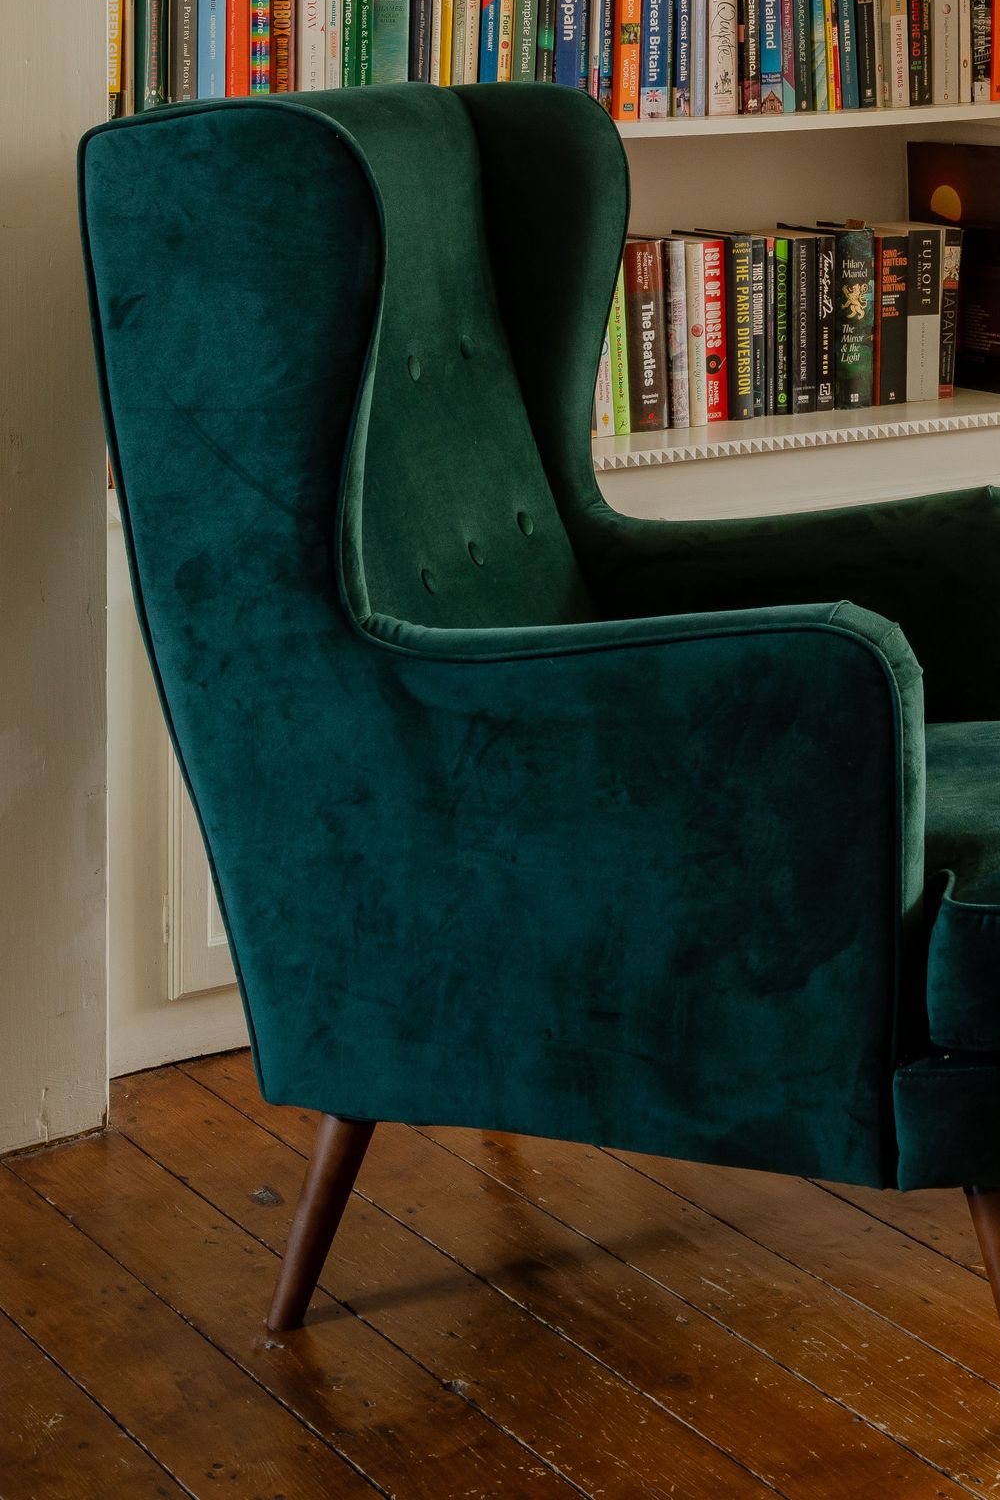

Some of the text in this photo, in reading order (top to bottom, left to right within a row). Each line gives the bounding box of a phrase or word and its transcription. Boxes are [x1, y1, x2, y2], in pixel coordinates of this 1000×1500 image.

[361, 30, 368, 38] &
[502, 15, 510, 36] Food
[711, 1, 736, 64] Quixote
[109, 42, 118, 85] GUIDE
[521, 38, 532, 74] Herbal
[603, 38, 611, 74] Bulgaria
[630, 49, 637, 62] MY
[649, 36, 660, 82] Britain
[637, 275, 643, 284] Of
[842, 259, 866, 269] Hilary
[842, 269, 868, 278] Mantel
[922, 239, 932, 305] EUROPE
[705, 247, 721, 348] ISLE OF NOISES
[752, 262, 763, 335] THIS IS GOMORRAH
[777, 264, 787, 343] COCKTAILS
[942, 291, 953, 345] JAPAN
[641, 301, 656, 387] The Beatles
[736, 257, 751, 395] THE PARIS DIVERSION
[843, 324, 854, 333] The
